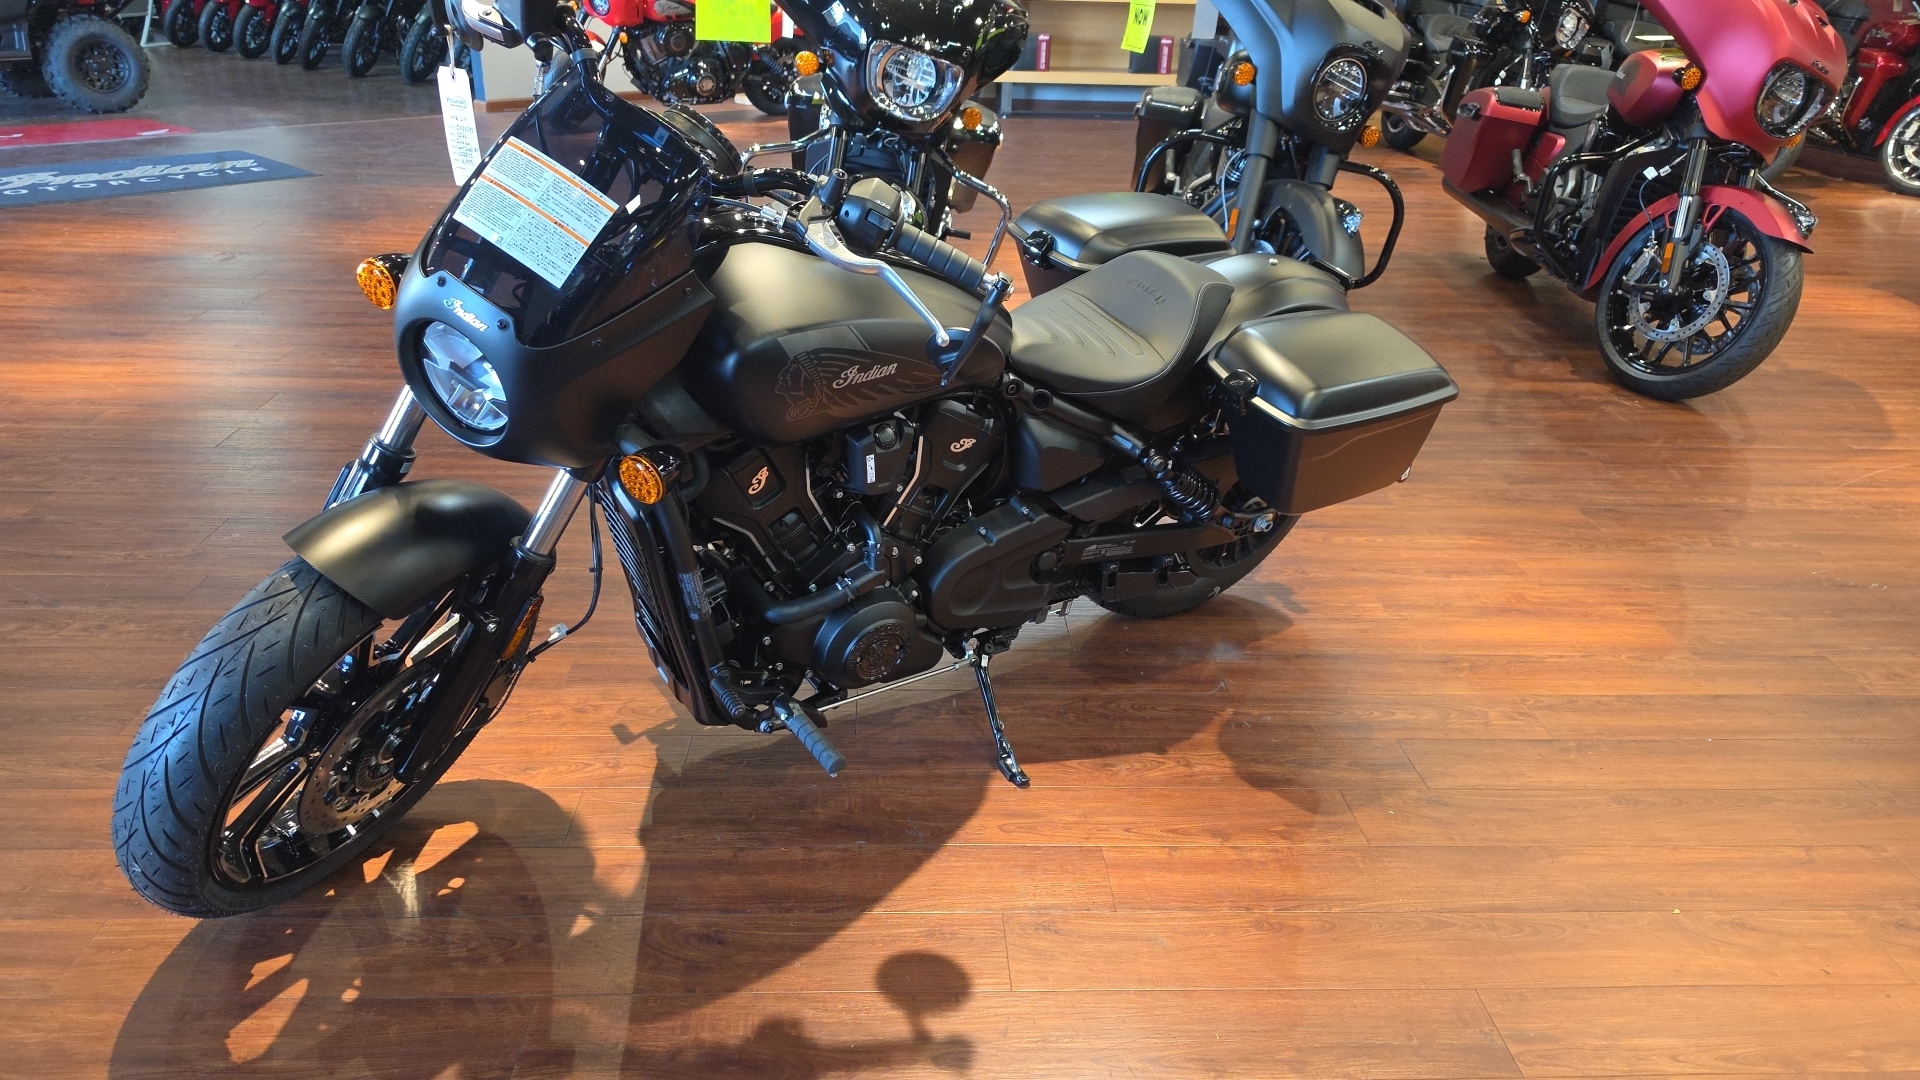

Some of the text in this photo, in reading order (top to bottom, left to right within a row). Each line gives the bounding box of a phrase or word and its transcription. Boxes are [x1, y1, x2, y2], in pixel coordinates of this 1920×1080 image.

[1133, 8, 1150, 26] NOW
[2, 167, 268, 195] OTORCYCLE
[443, 298, 489, 332] Indian
[832, 363, 898, 389] Indian
